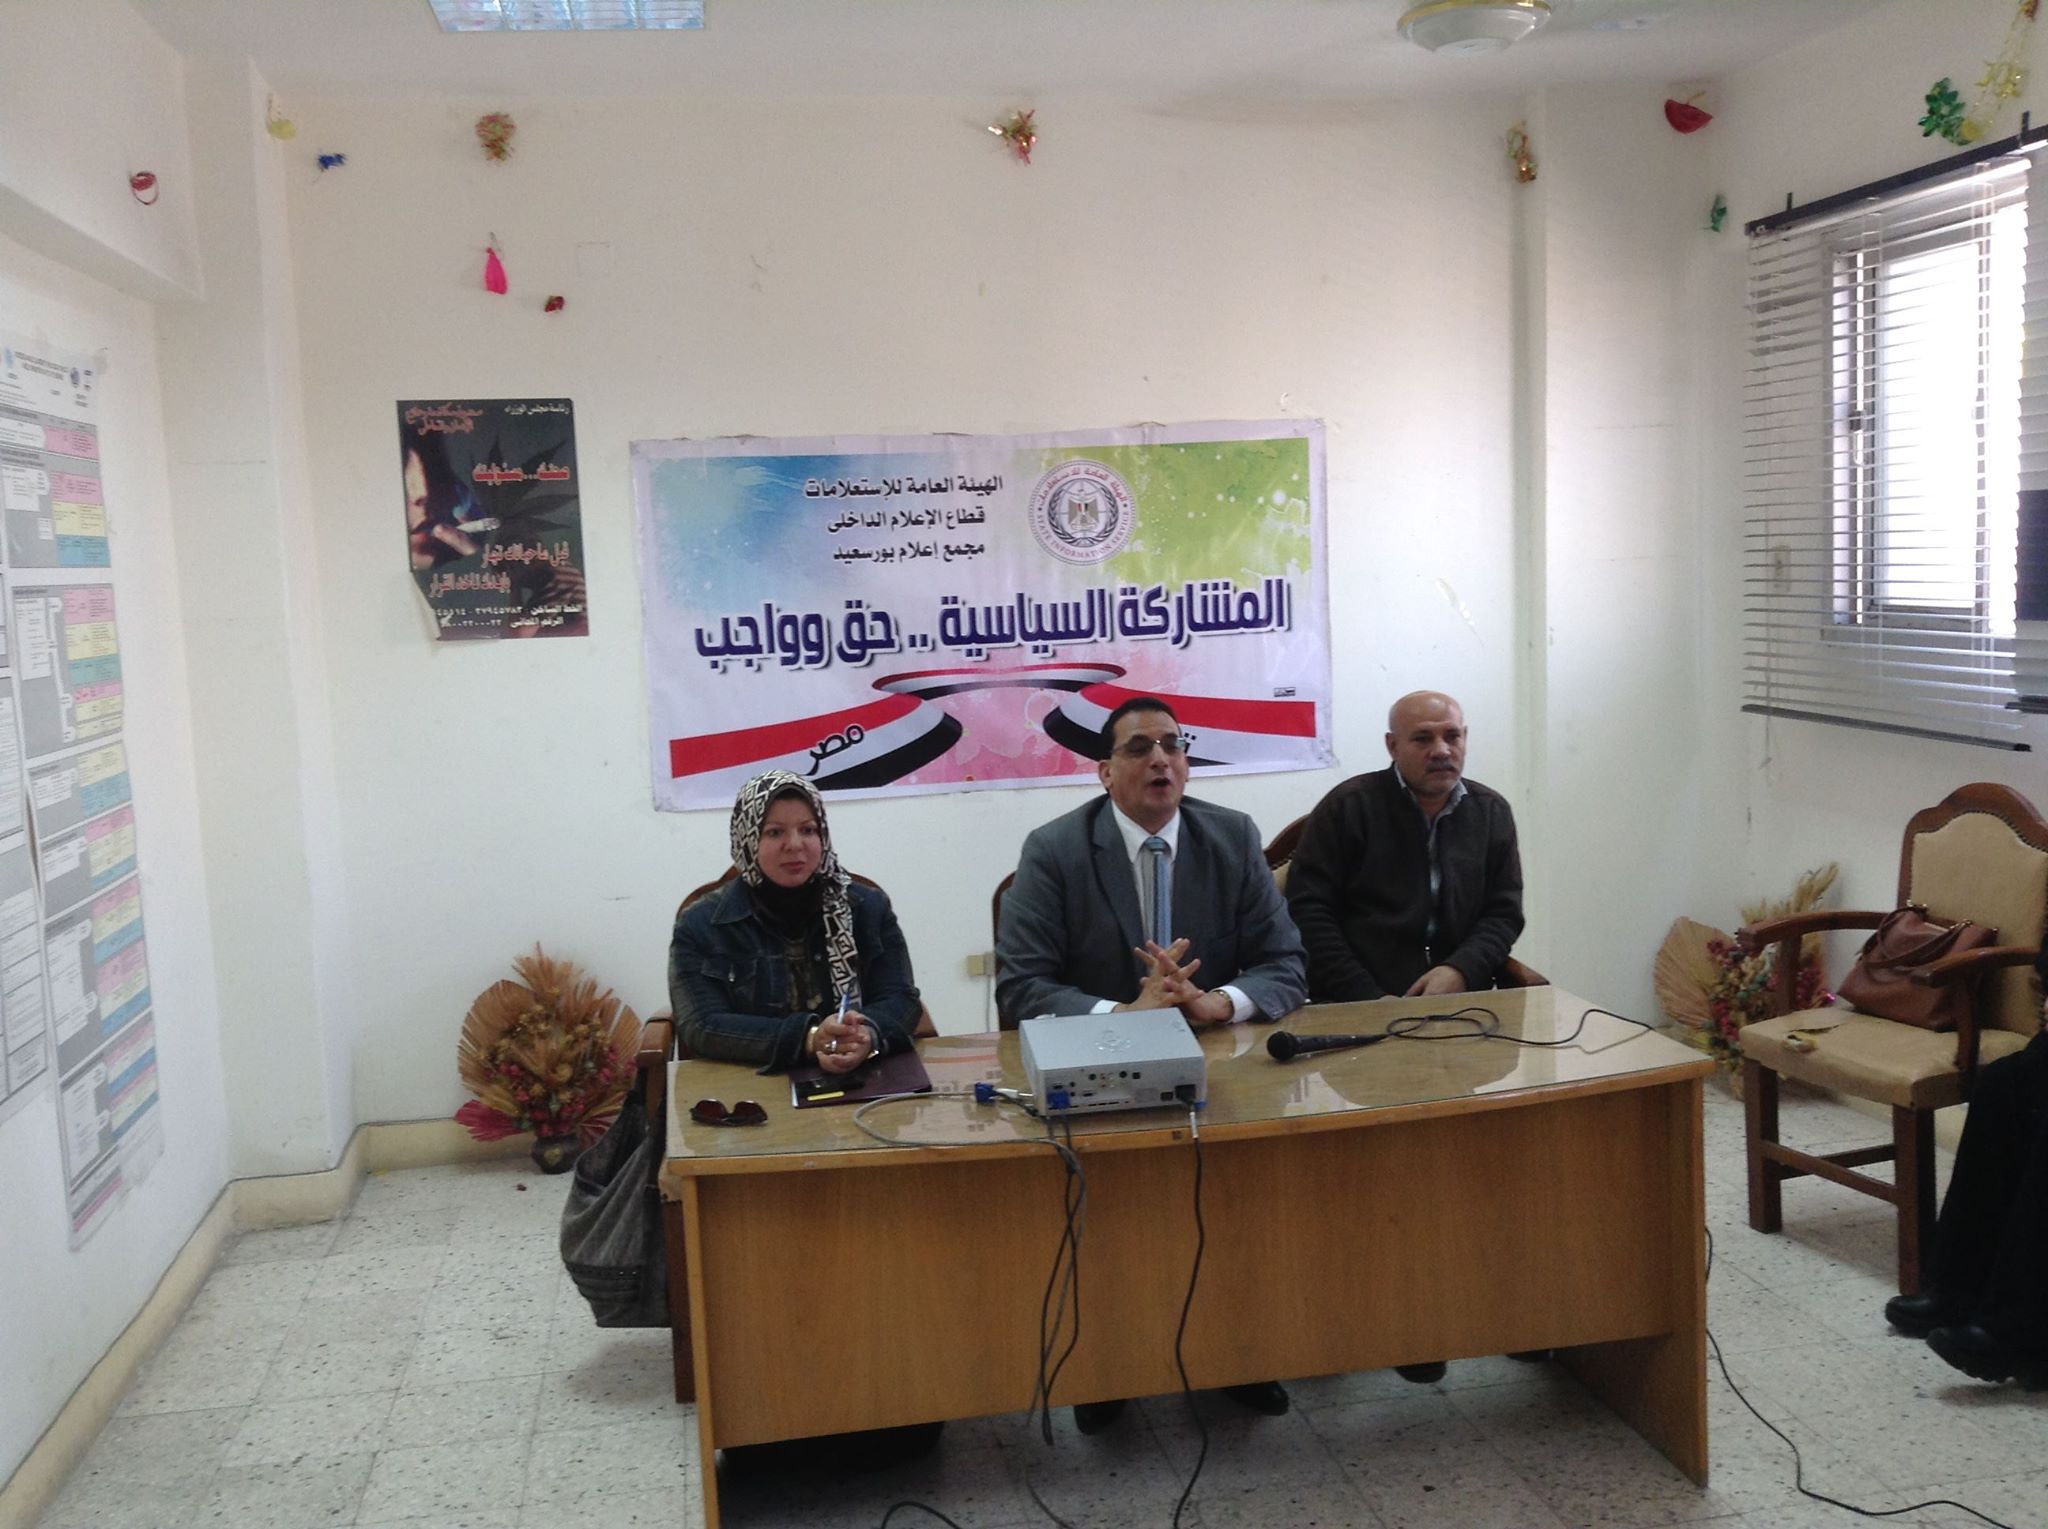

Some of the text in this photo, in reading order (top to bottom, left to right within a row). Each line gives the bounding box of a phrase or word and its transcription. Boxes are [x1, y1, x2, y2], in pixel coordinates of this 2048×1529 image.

[806, 475, 1003, 500] الهيئة العامة للإستعلامات
[891, 508, 942, 531] الإعلام
[946, 505, 985, 529] قطاع
[833, 541, 985, 564] مجمع إعلام بورسعيد
[695, 602, 826, 668] وواجب
[837, 599, 897, 663] حق
[939, 587, 1108, 658] السياسية
[1118, 578, 1286, 646] المشاركة
[805, 724, 864, 776] مصر
